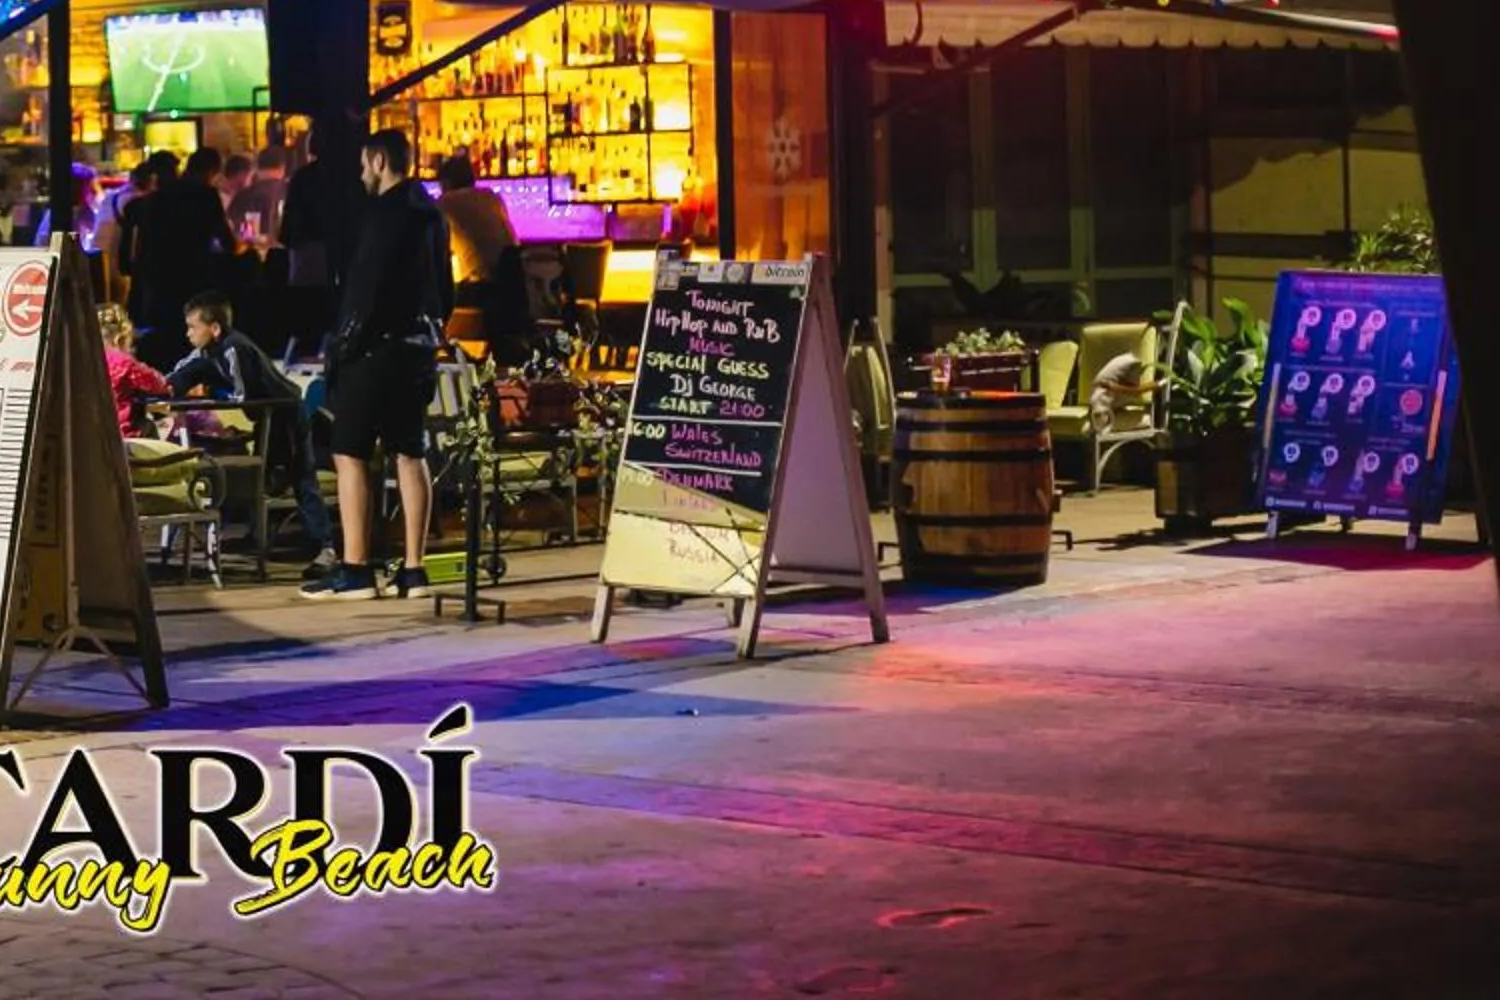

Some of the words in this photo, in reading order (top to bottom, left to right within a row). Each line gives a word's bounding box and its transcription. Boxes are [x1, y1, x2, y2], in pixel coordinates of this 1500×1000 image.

[717, 358, 770, 379] GUESS
[699, 376, 757, 401] GEORGE
[659, 397, 713, 416] START
[719, 402, 766, 419] 21:00
